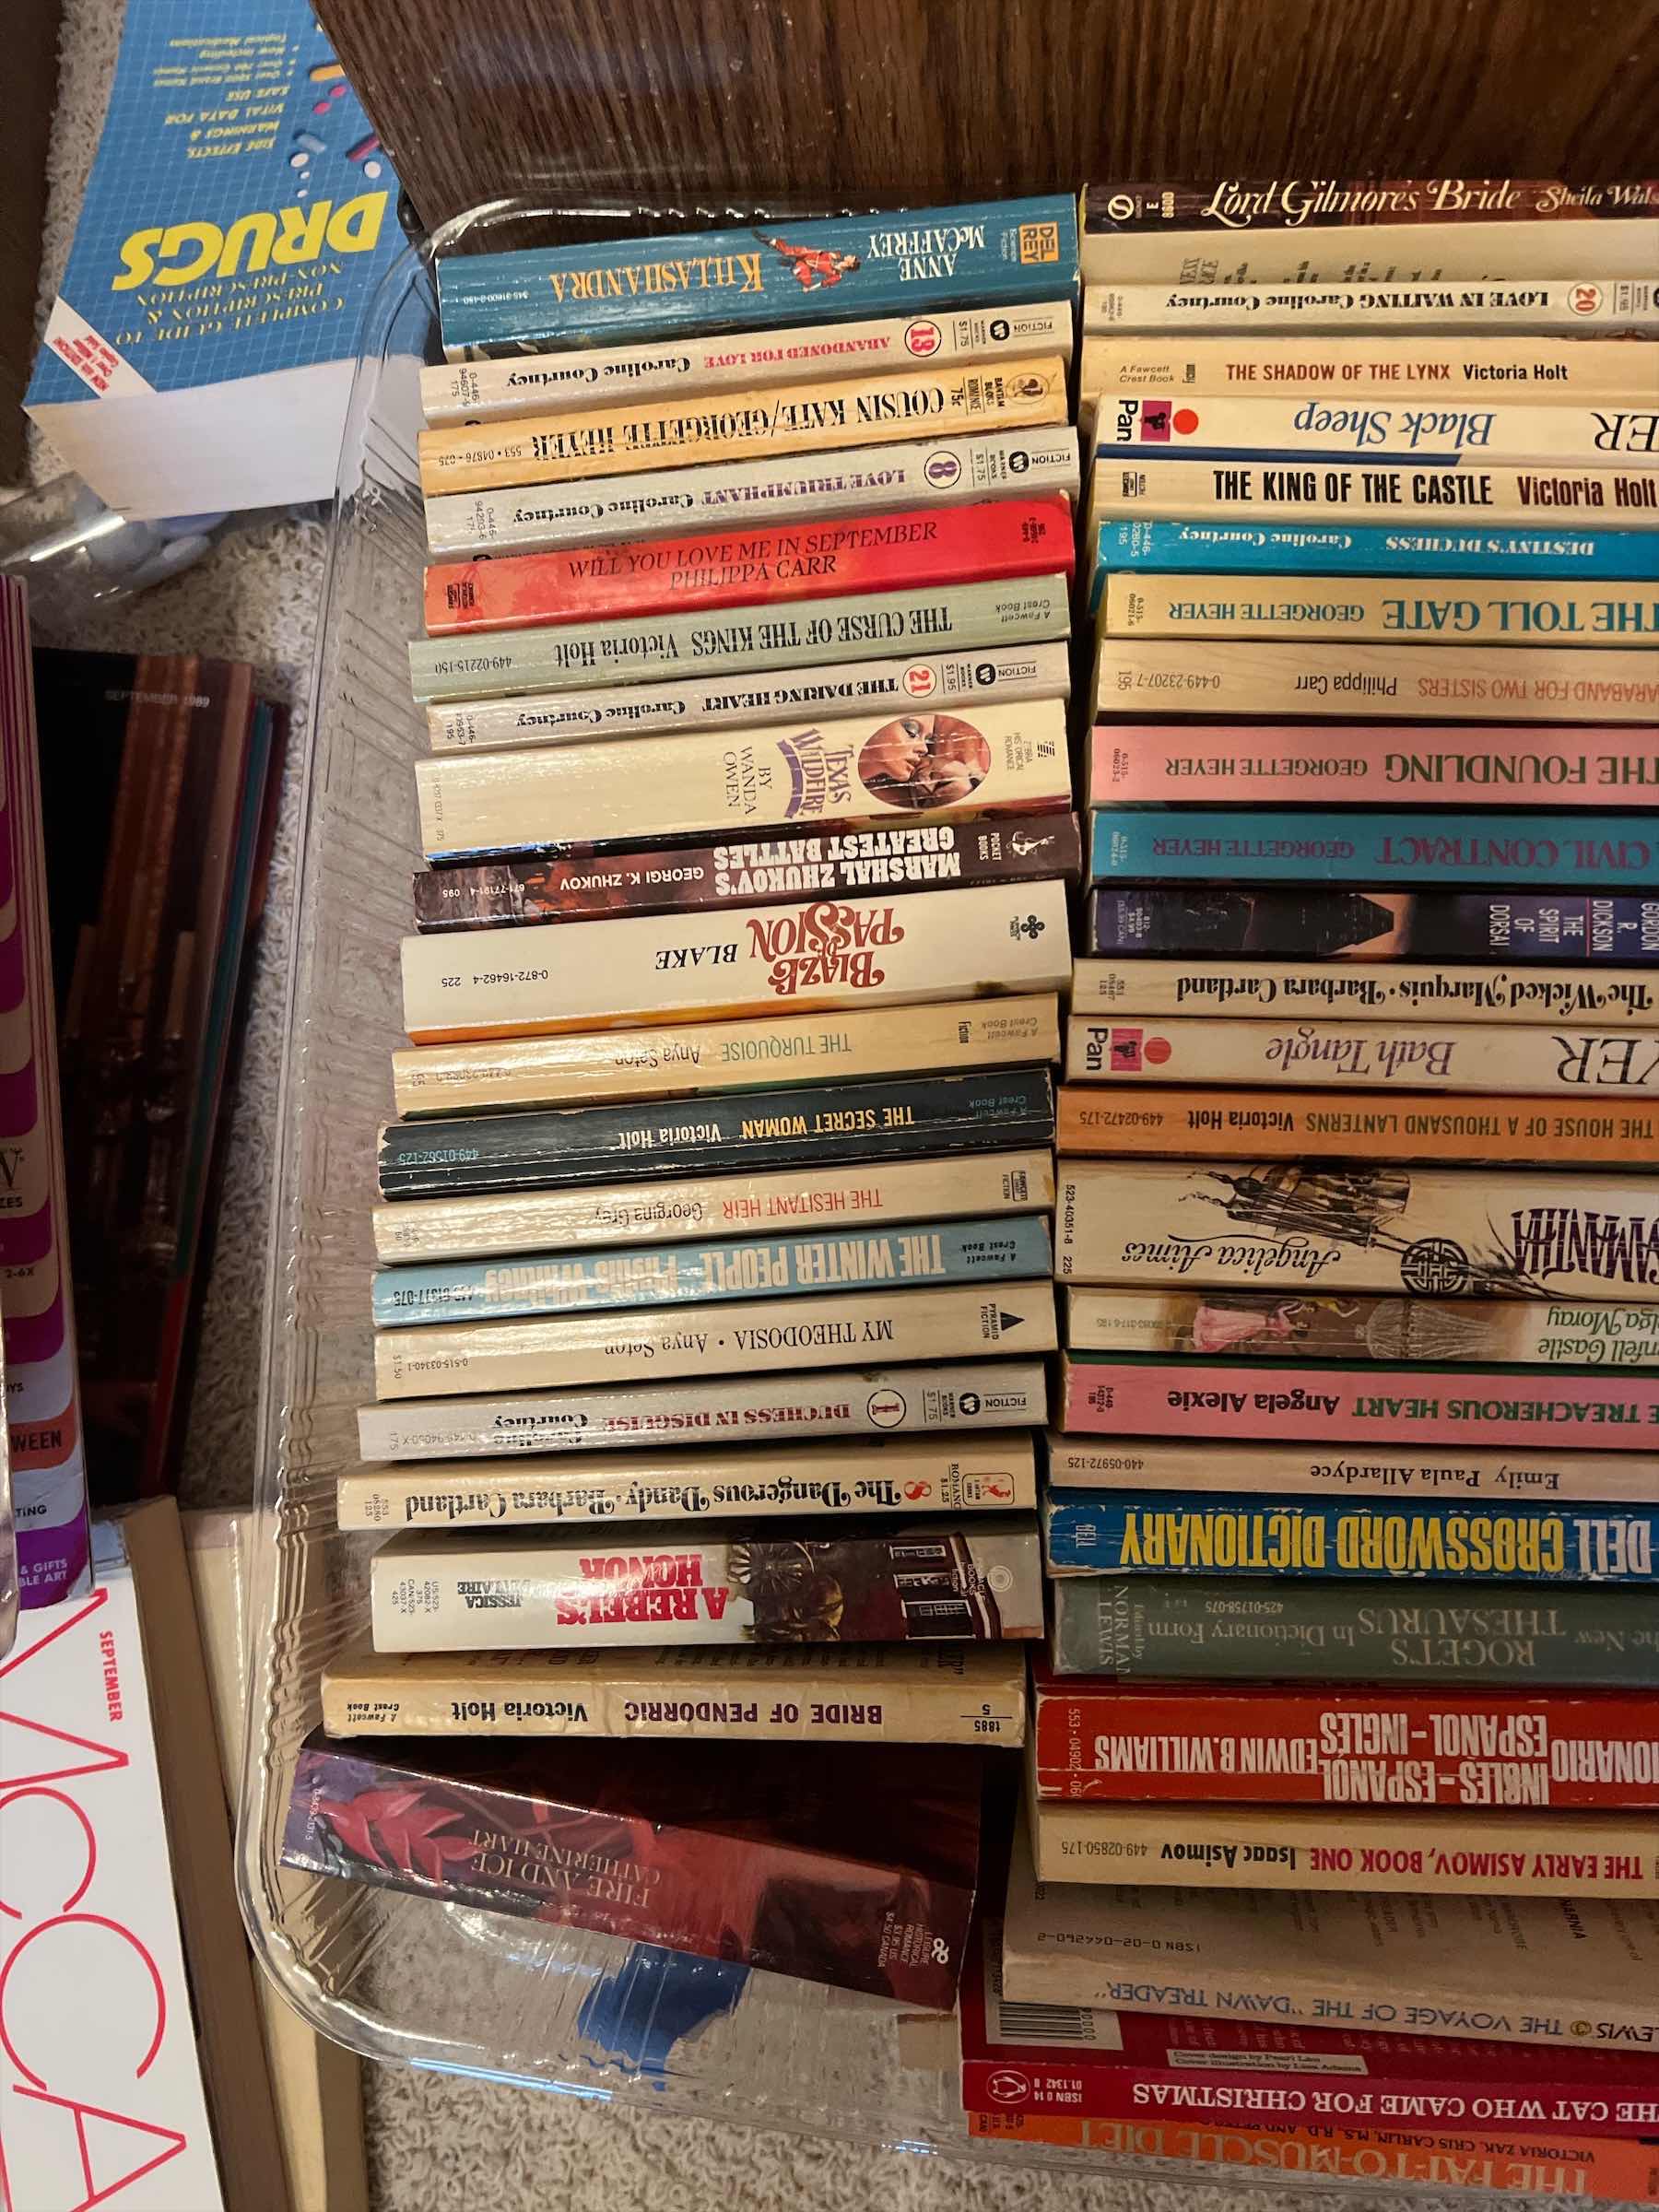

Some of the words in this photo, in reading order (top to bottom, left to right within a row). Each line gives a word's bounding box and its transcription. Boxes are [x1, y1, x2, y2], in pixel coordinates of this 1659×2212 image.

[199, 108, 240, 122] DATA
[112, 191, 389, 290] DRUGS
[866, 225, 985, 258] McCAFFREY
[1022, 228, 1039, 260] REY
[1040, 226, 1054, 260] DEL
[549, 253, 764, 302] KILLASHANDRA
[899, 253, 957, 280] ANNE
[1166, 295, 1261, 312] Courtney
[1265, 295, 1354, 310] Caroline
[1360, 293, 1453, 311] WAITING
[1460, 292, 1484, 308] IN
[1490, 291, 1548, 307] LOVE
[1576, 288, 1597, 312] 20
[147, 311, 162, 324] &
[234, 297, 345, 331] COMPLETE
[1014, 322, 1053, 330] FICTION
[115, 332, 142, 345] TO
[1225, 364, 1257, 380] THE
[1264, 364, 1334, 380] SHADOW
[1342, 365, 1361, 380] OF
[1366, 365, 1400, 381] THE
[1406, 366, 1450, 381] LYNX
[1464, 365, 1527, 381] Victoria
[1534, 365, 1568, 381] Holt
[1117, 399, 1138, 442] Pan
[1293, 402, 1392, 448] Sheep
[1398, 412, 1497, 450] Black
[1032, 453, 1070, 465] FICTION
[1179, 527, 1265, 546] Courtney
[1271, 533, 1351, 549] Caroline
[1385, 536, 1482, 552] DUCHESS
[1487, 540, 1594, 556] DESTINY'S
[569, 557, 620, 578] WILL
[628, 552, 671, 569] YOU
[678, 545, 728, 563] LOVE
[737, 546, 771, 560] ME
[777, 538, 800, 556] IN
[806, 522, 937, 555] SEPTEMBER
[671, 562, 767, 591] PHILIPPA
[776, 556, 836, 576] CARR
[995, 602, 1019, 613] Book
[1022, 599, 1051, 610] Crest
[1169, 602, 1236, 620] HEYER
[1241, 603, 1364, 622] GEORGETTE
[1382, 599, 1481, 631] GATE
[1488, 601, 1584, 632] TOLL
[836, 612, 905, 641] CURSE
[911, 606, 952, 635] THE
[1592, 602, 1659, 633] THE
[690, 626, 753, 656] KINGS
[759, 621, 801, 650] THE
[806, 619, 833, 645] OF
[553, 641, 595, 668] Holt
[600, 633, 679, 663] Victoria
[947, 664, 958, 691] $1.95
[998, 665, 1036, 677] FICTION
[1118, 670, 1132, 692] 195
[774, 683, 853, 702] DARING
[857, 678, 898, 694] THE
[605, 700, 686, 720] Caroline
[702, 691, 769, 712] HEART
[515, 709, 602, 728] Courtney
[723, 751, 737, 808] OWEN
[744, 747, 757, 815] WANDA
[759, 767, 771, 790] BY
[712, 838, 822, 871] BATTLES
[827, 826, 955, 860] GREATEST
[979, 835, 988, 860] BOOKS
[714, 864, 836, 897] ZHUKOV'S
[841, 853, 960, 887] MARSHAL
[746, 902, 904, 961] PASSION
[1539, 908, 1559, 944] SPIRIT
[1593, 900, 1613, 951] DICKSON
[655, 945, 738, 971] BLAKE
[441, 976, 462, 988] 225
[473, 969, 549, 984] 0-872-16462-4
[767, 952, 885, 995] BLAZE
[1177, 978, 1277, 1003] Cartland
[1284, 979, 1384, 1005] Barbara
[1399, 974, 1507, 1006] Marquis
[1510, 983, 1605, 1017] Wicked
[1607, 984, 1653, 1016] The
[721, 1035, 813, 1061] TURQUOISE
[818, 1033, 852, 1053] THE
[1265, 1027, 1370, 1074] Tangle
[1377, 1040, 1457, 1077] Bath
[1079, 1112, 1164, 1124] 449-02472-175
[1188, 1110, 1222, 1130] Holt
[1229, 1110, 1294, 1132] Victoria
[1306, 1113, 1398, 1134] LANTERNS
[1405, 1114, 1500, 1135] THOUSAND
[1508, 1117, 1519, 1135] A
[1525, 1117, 1547, 1136] OF
[1554, 1118, 1614, 1138] HOUSE
[1620, 1118, 1653, 1139] THE
[897, 1234, 946, 1276] THE
[960, 1241, 984, 1253] Book
[989, 1241, 1016, 1252] Crest
[1121, 1243, 1211, 1274] Aimes
[699, 1247, 790, 1293] PEOPLE
[794, 1240, 895, 1285] WINTER
[1063, 1256, 1072, 1275] 225
[1218, 1241, 1341, 1279] Angelica
[985, 1397, 1027, 1407] FICTION
[1168, 1391, 1248, 1413] Alexie
[1254, 1389, 1341, 1417] Angela
[1352, 1397, 1439, 1418] HEART
[1446, 1400, 1641, 1423] TREACHEROUS
[1067, 1457, 1145, 1470] 440-05972-125
[1311, 1461, 1415, 1484] Allardyce
[1421, 1468, 1480, 1488] Paula
[1495, 1466, 1559, 1490] Emily
[1120, 1512, 1324, 1569] DICTIONARY
[1336, 1515, 1564, 1572] CROSSWORD
[1572, 1519, 1652, 1573] DELL
[33, 1559, 67, 1572] GIFTS
[44, 1571, 66, 1583] ART
[1098, 1601, 1112, 1665] LEWIS
[1147, 1622, 1206, 1644] Form
[1210, 1618, 1326, 1647] Dictionary
[1357, 1607, 1564, 1637] THESAURUS
[1331, 1624, 1356, 1646] In
[1390, 1637, 1535, 1666] ROGET'S
[100, 1630, 123, 1722] SEPTEMBER
[451, 1702, 496, 1723] Holt
[503, 1701, 588, 1722] Victoria
[624, 1702, 759, 1723] PENDORRIC
[770, 1703, 799, 1723] OF
[810, 1704, 882, 1724] BRIDE
[982, 1704, 991, 1715] 5
[1160, 1842, 1238, 1869] Asimov
[1243, 1845, 1296, 1871] Isaac
[1310, 1847, 1352, 1872] ONE
[1361, 1850, 1423, 1874] BOOK
[1426, 1849, 1525, 1877] ASIMOV,
[1531, 1854, 1597, 1878] EARLY
[1604, 1856, 1643, 1879] THE
[1312, 1999, 1354, 2019] THE
[1361, 2005, 1396, 2021] OF
[1404, 2007, 1511, 2031] VOYAGE
[1519, 2017, 1563, 2036] THE
[1133, 2083, 1306, 2112] CHRISTMAS
[1312, 2091, 1373, 2114] FOR
[1381, 2093, 1465, 2117] CAME
[1473, 2098, 1547, 2120] WHO
[1551, 2100, 1609, 2121] CAT
